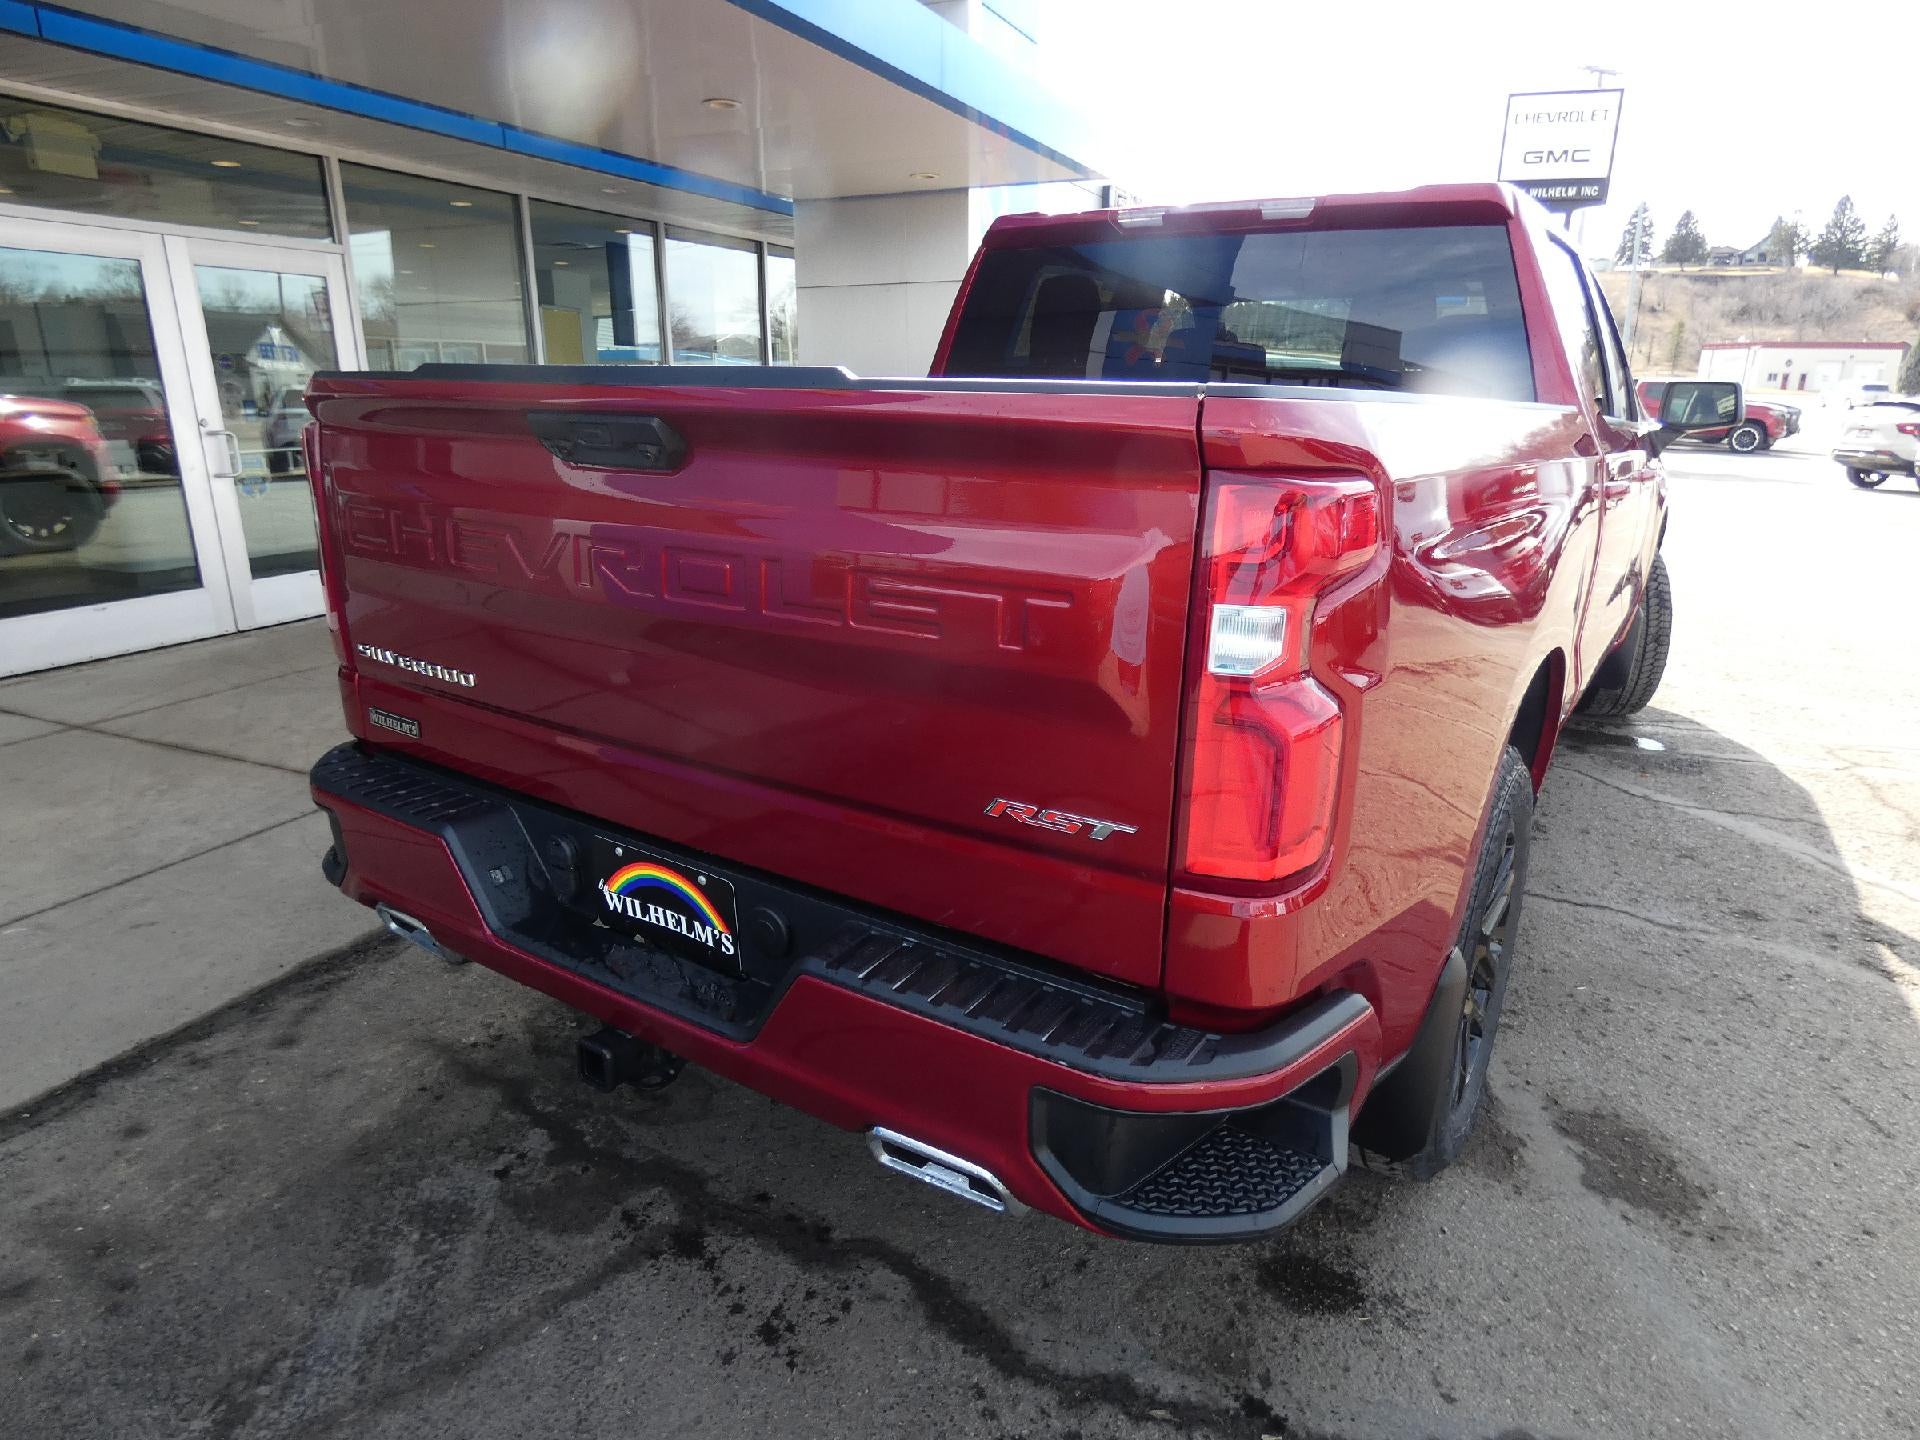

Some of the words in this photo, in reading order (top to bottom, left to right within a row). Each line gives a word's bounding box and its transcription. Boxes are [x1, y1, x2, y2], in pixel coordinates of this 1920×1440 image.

[1515, 109, 1608, 124] CHEVROLET
[1524, 149, 1590, 164] GMC
[1530, 187, 1577, 198] WILHELM
[346, 501, 1074, 651] CHEVROLET
[358, 644, 476, 687] SILVERADO
[371, 711, 417, 736] WILHELM'S
[983, 797, 1140, 841] RST
